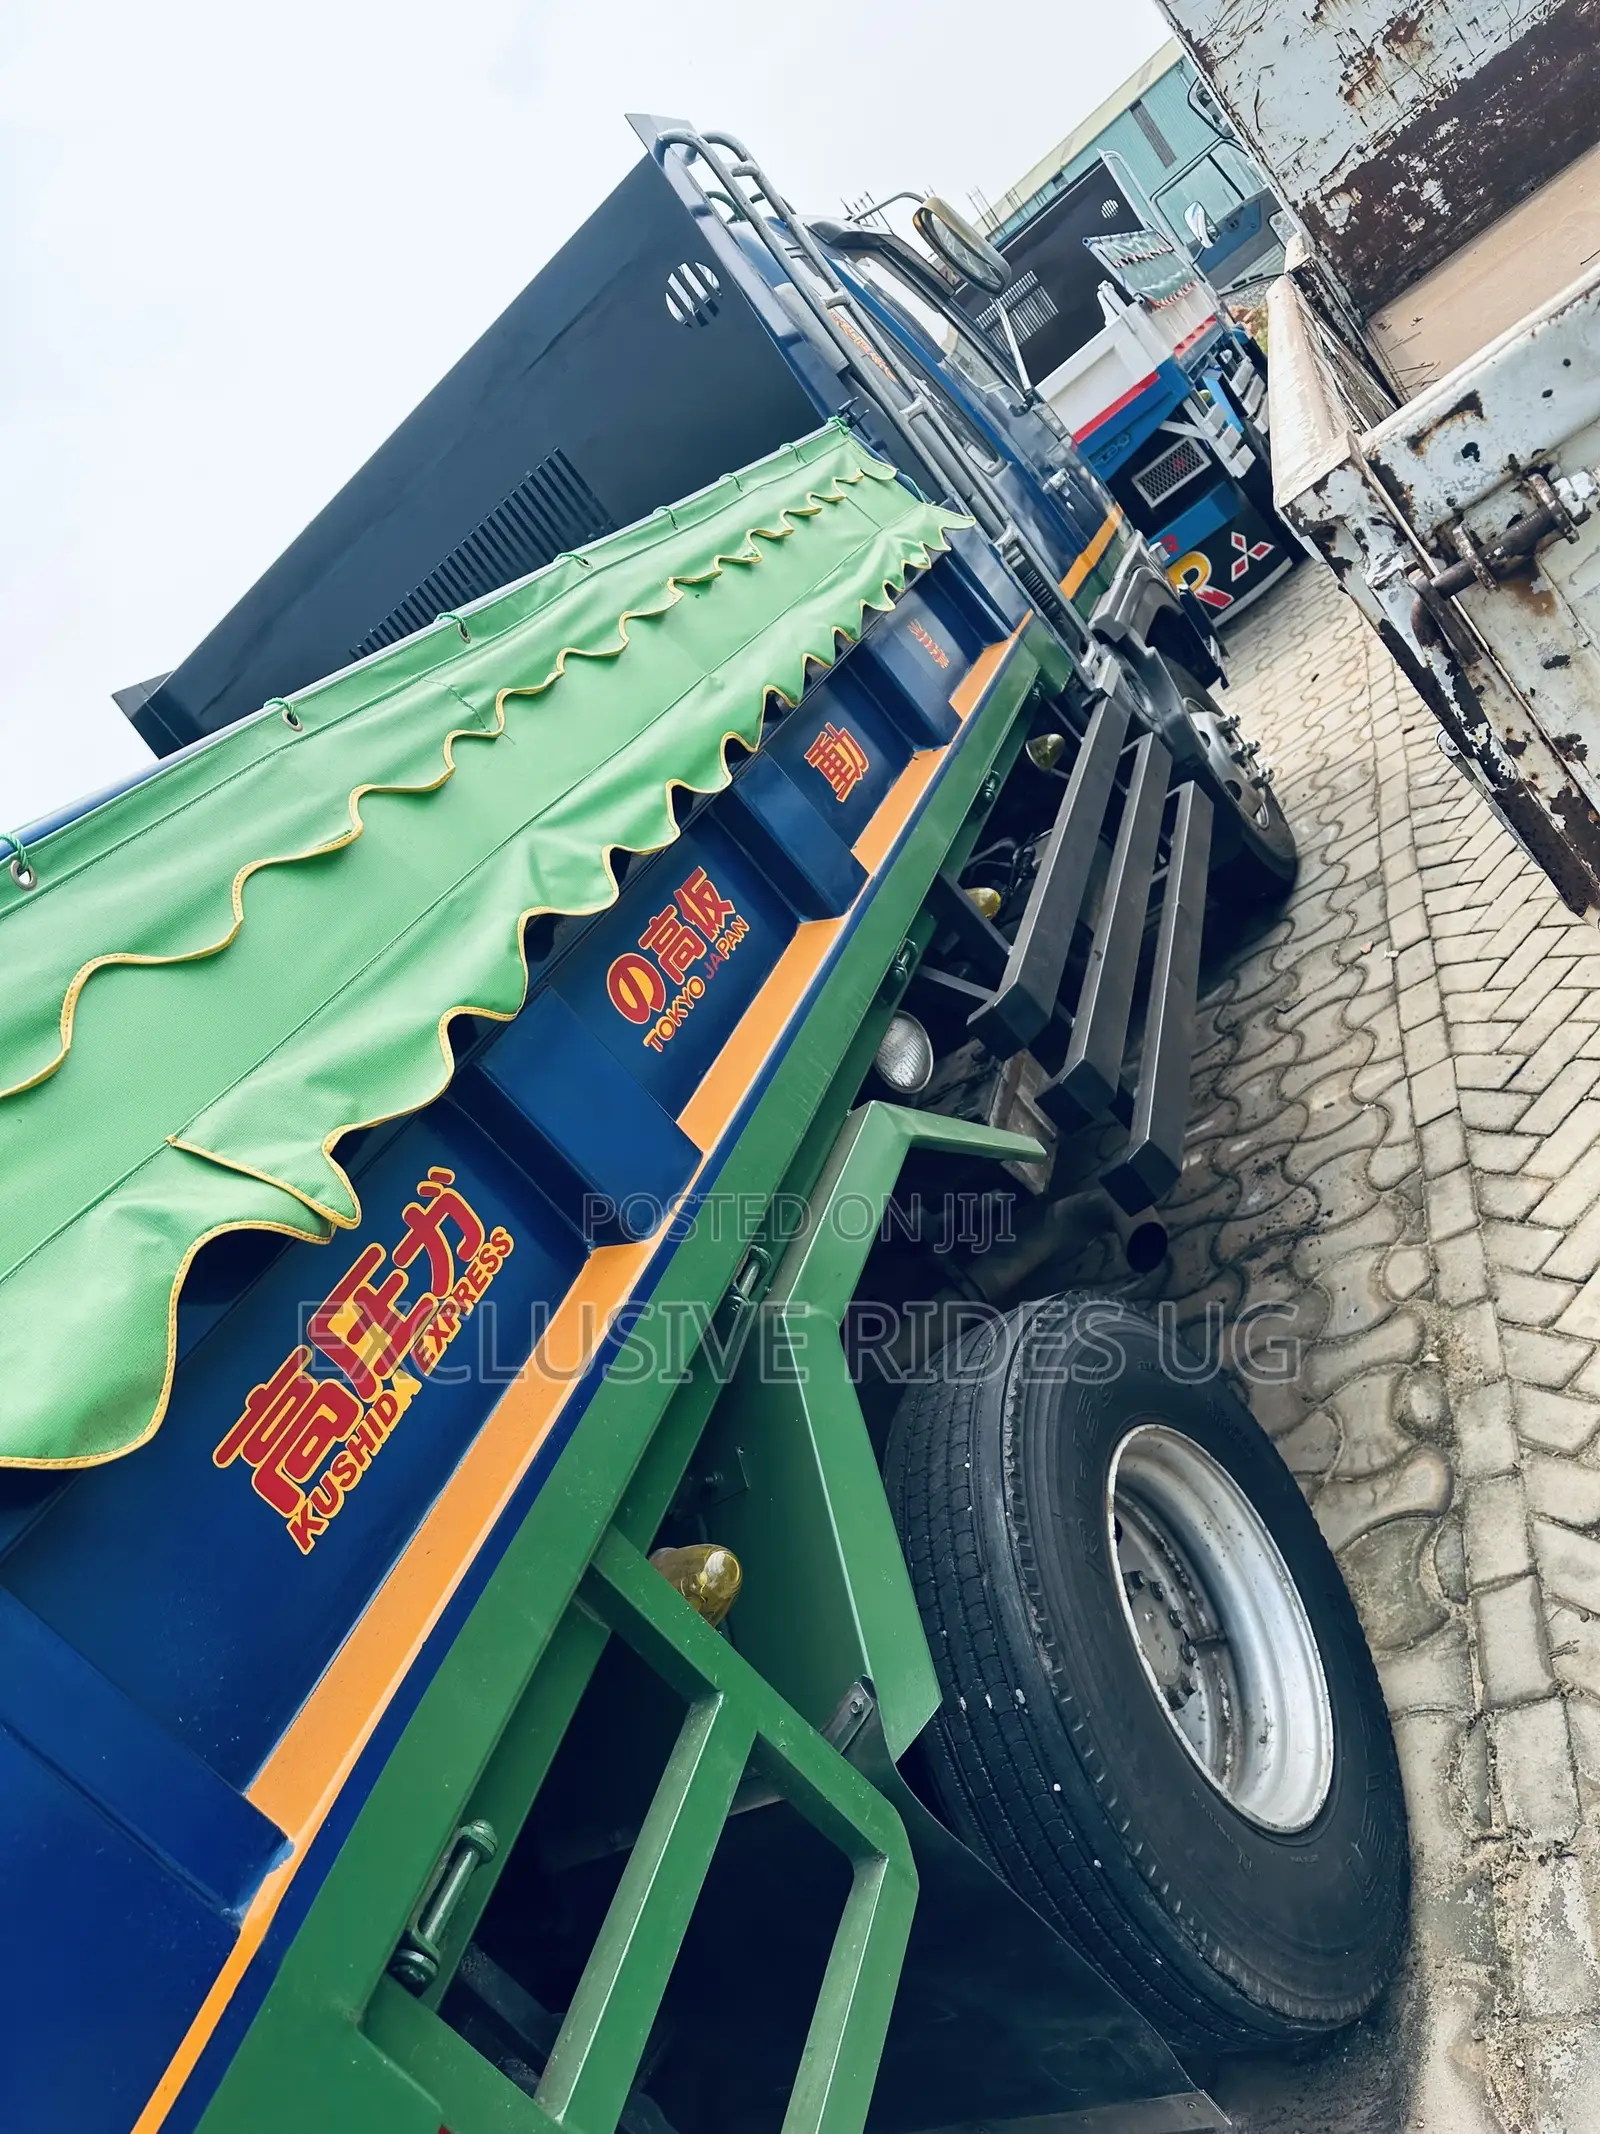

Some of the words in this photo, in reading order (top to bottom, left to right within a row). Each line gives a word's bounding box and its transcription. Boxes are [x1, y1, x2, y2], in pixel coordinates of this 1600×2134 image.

[804, 722, 870, 803] 動
[643, 975, 705, 1052] TOKYO
[704, 915, 750, 981] JAPAN
[410, 1226, 515, 1379] EXPRESS
